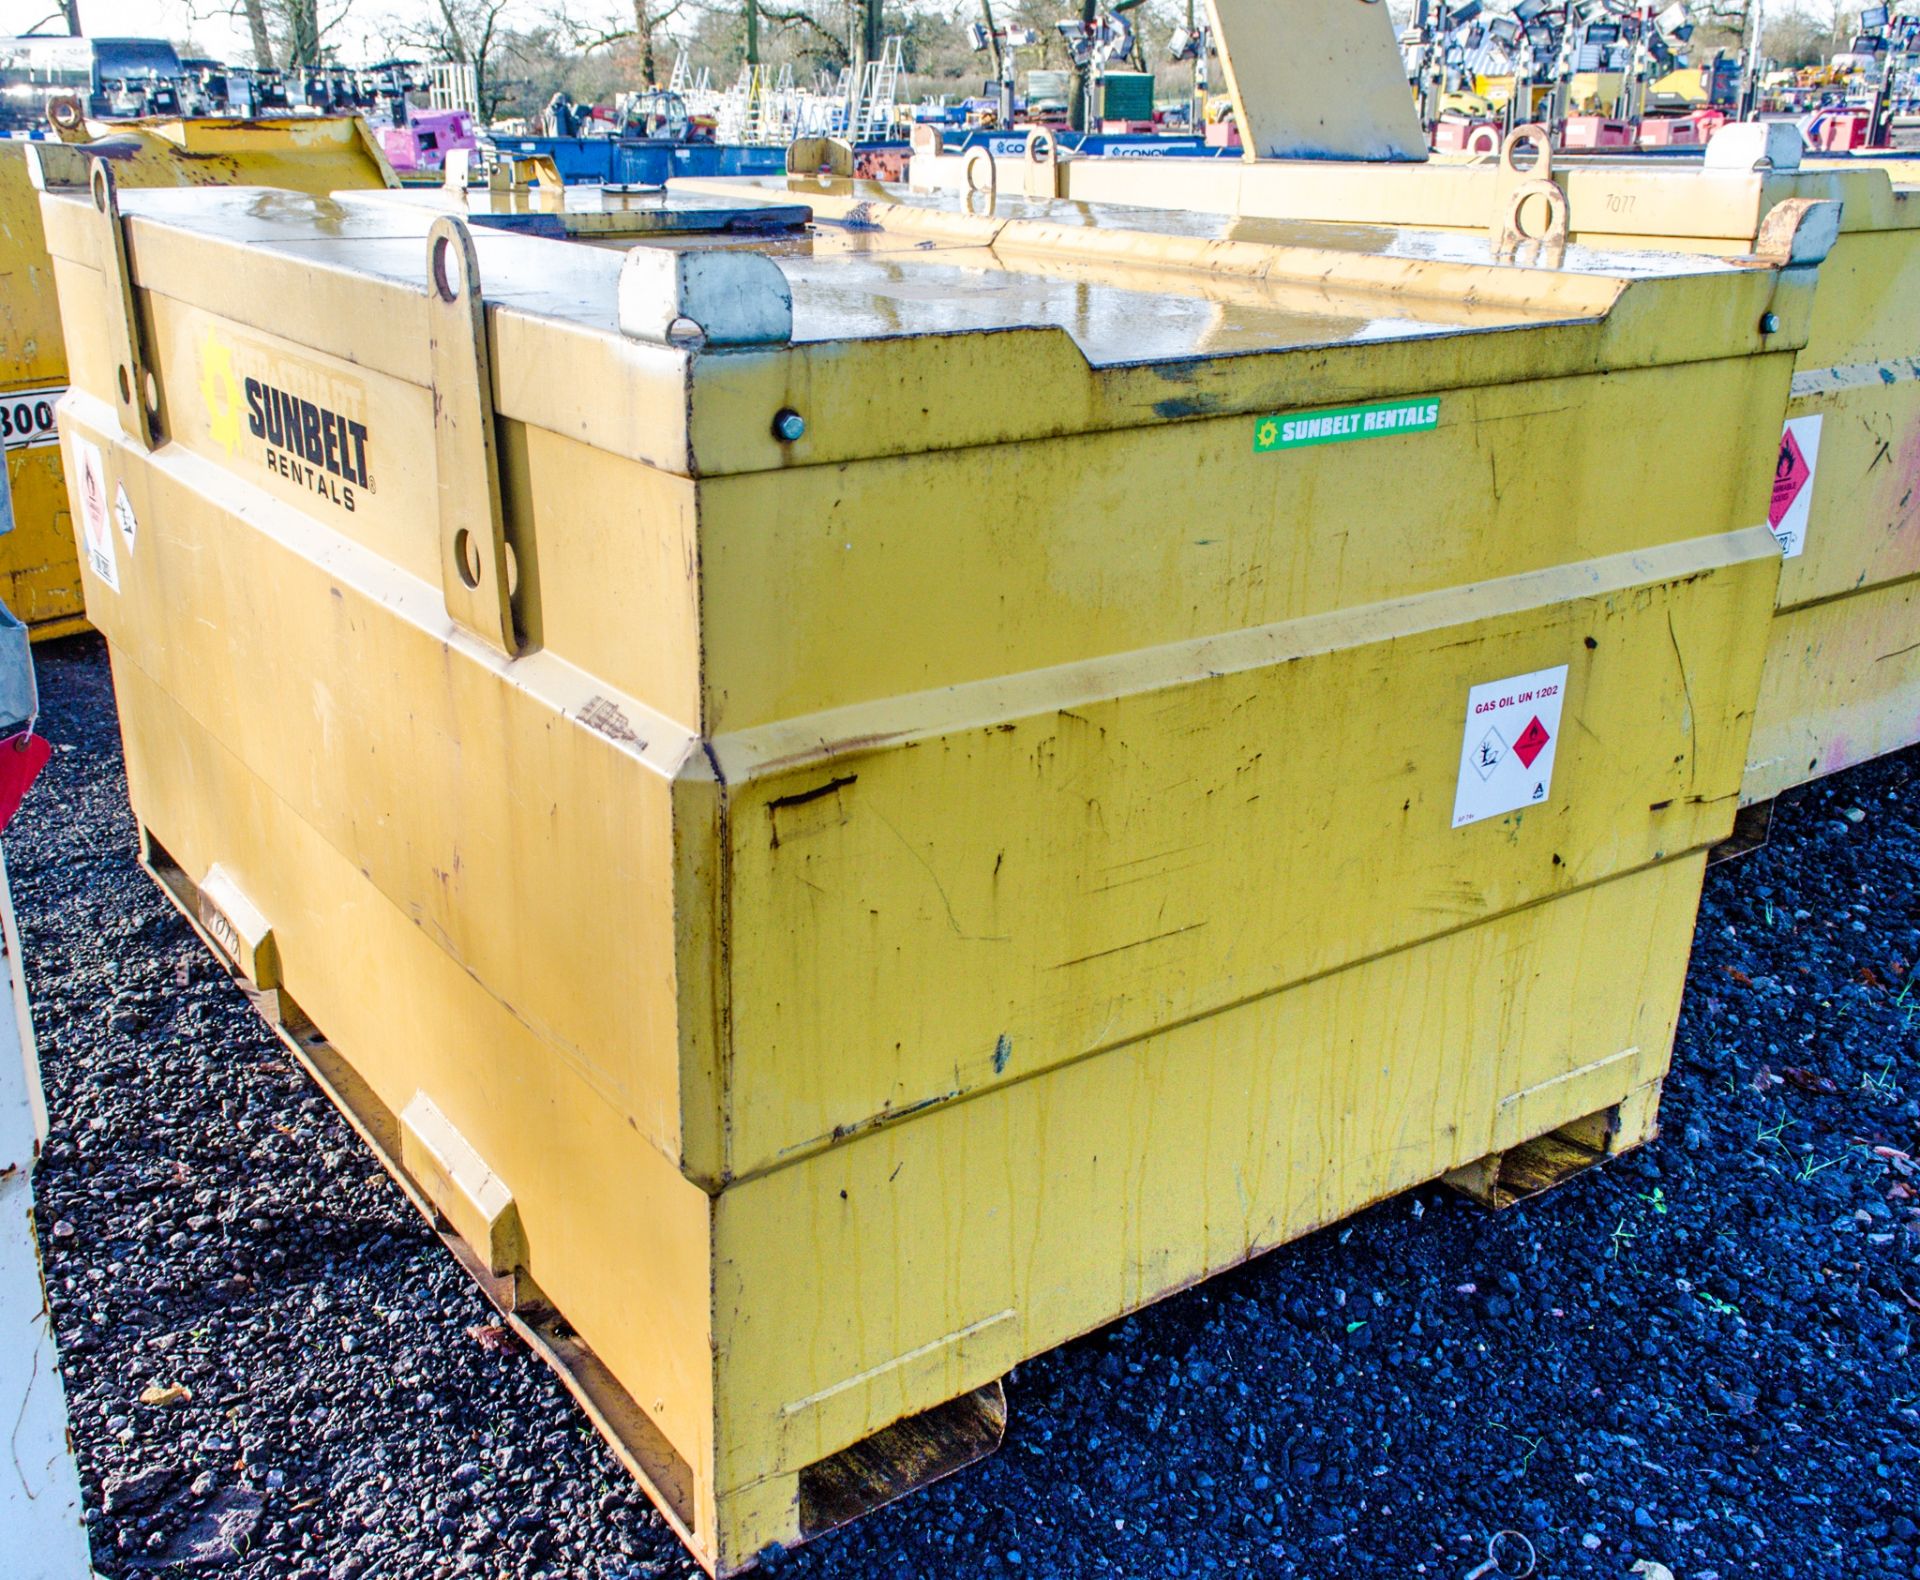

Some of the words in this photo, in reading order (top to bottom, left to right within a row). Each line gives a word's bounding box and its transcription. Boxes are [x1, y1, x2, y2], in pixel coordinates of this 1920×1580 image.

[244, 376, 369, 490] SUNBELT
[1282, 413, 1362, 442] SUNBELT
[1363, 404, 1439, 432] RENTALS
[266, 448, 356, 513] RENTALS
[1475, 700, 1496, 714] GAS
[1498, 695, 1515, 708] OIL
[1518, 691, 1533, 704] UN
[1536, 685, 1559, 699] 1202
